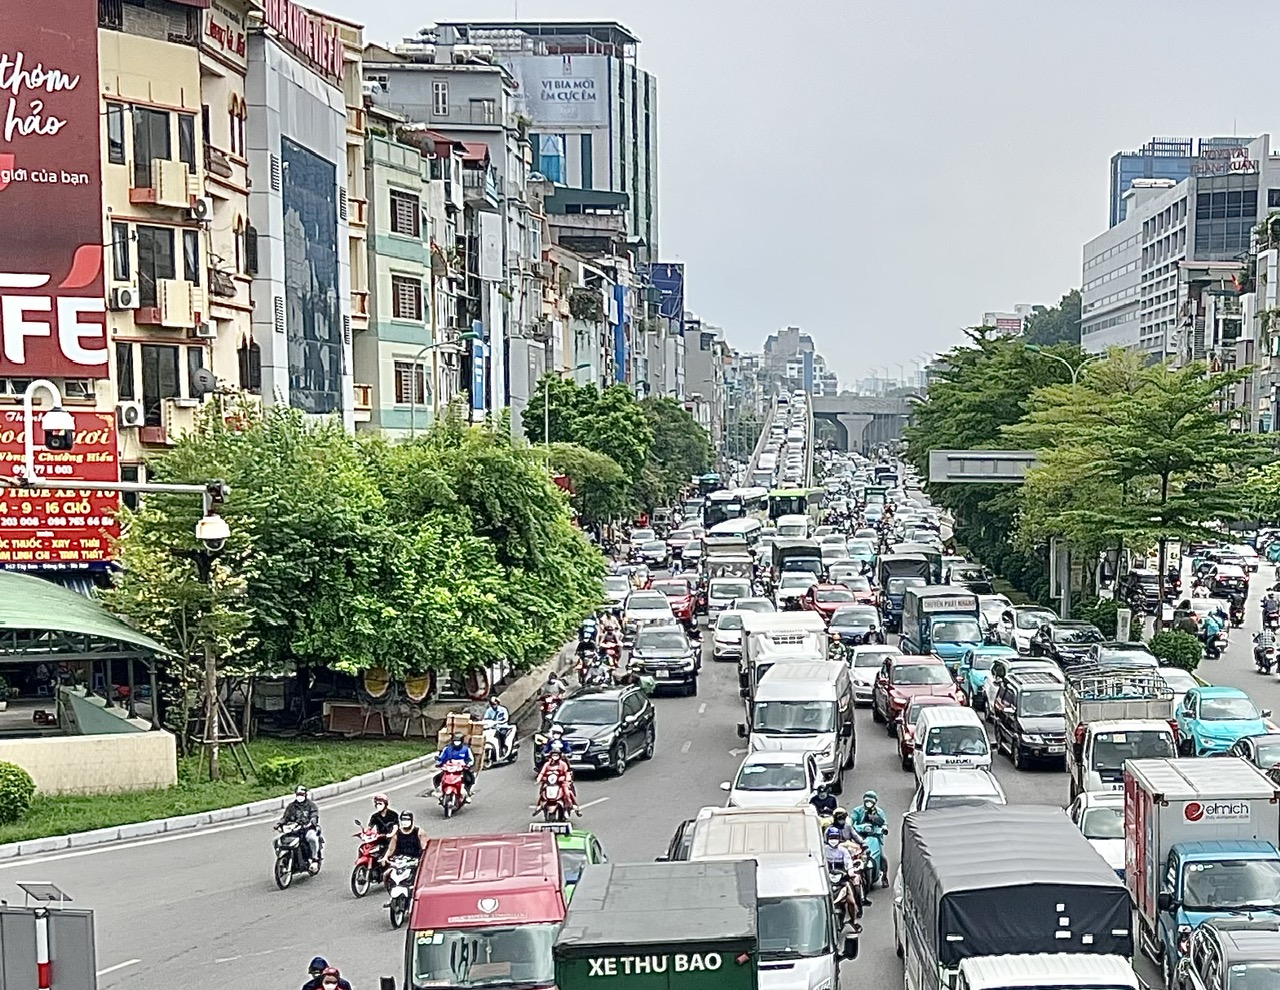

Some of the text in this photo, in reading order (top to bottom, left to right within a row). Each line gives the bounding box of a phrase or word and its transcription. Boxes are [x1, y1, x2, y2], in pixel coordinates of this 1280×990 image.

[554, 80, 571, 89] BIA
[4, 97, 68, 142] hảo
[31, 169, 58, 183] của
[61, 171, 89, 186] bạn
[21, 502, 32, 514] 9
[1206, 802, 1249, 815] elmich
[588, 958, 617, 977] XE
